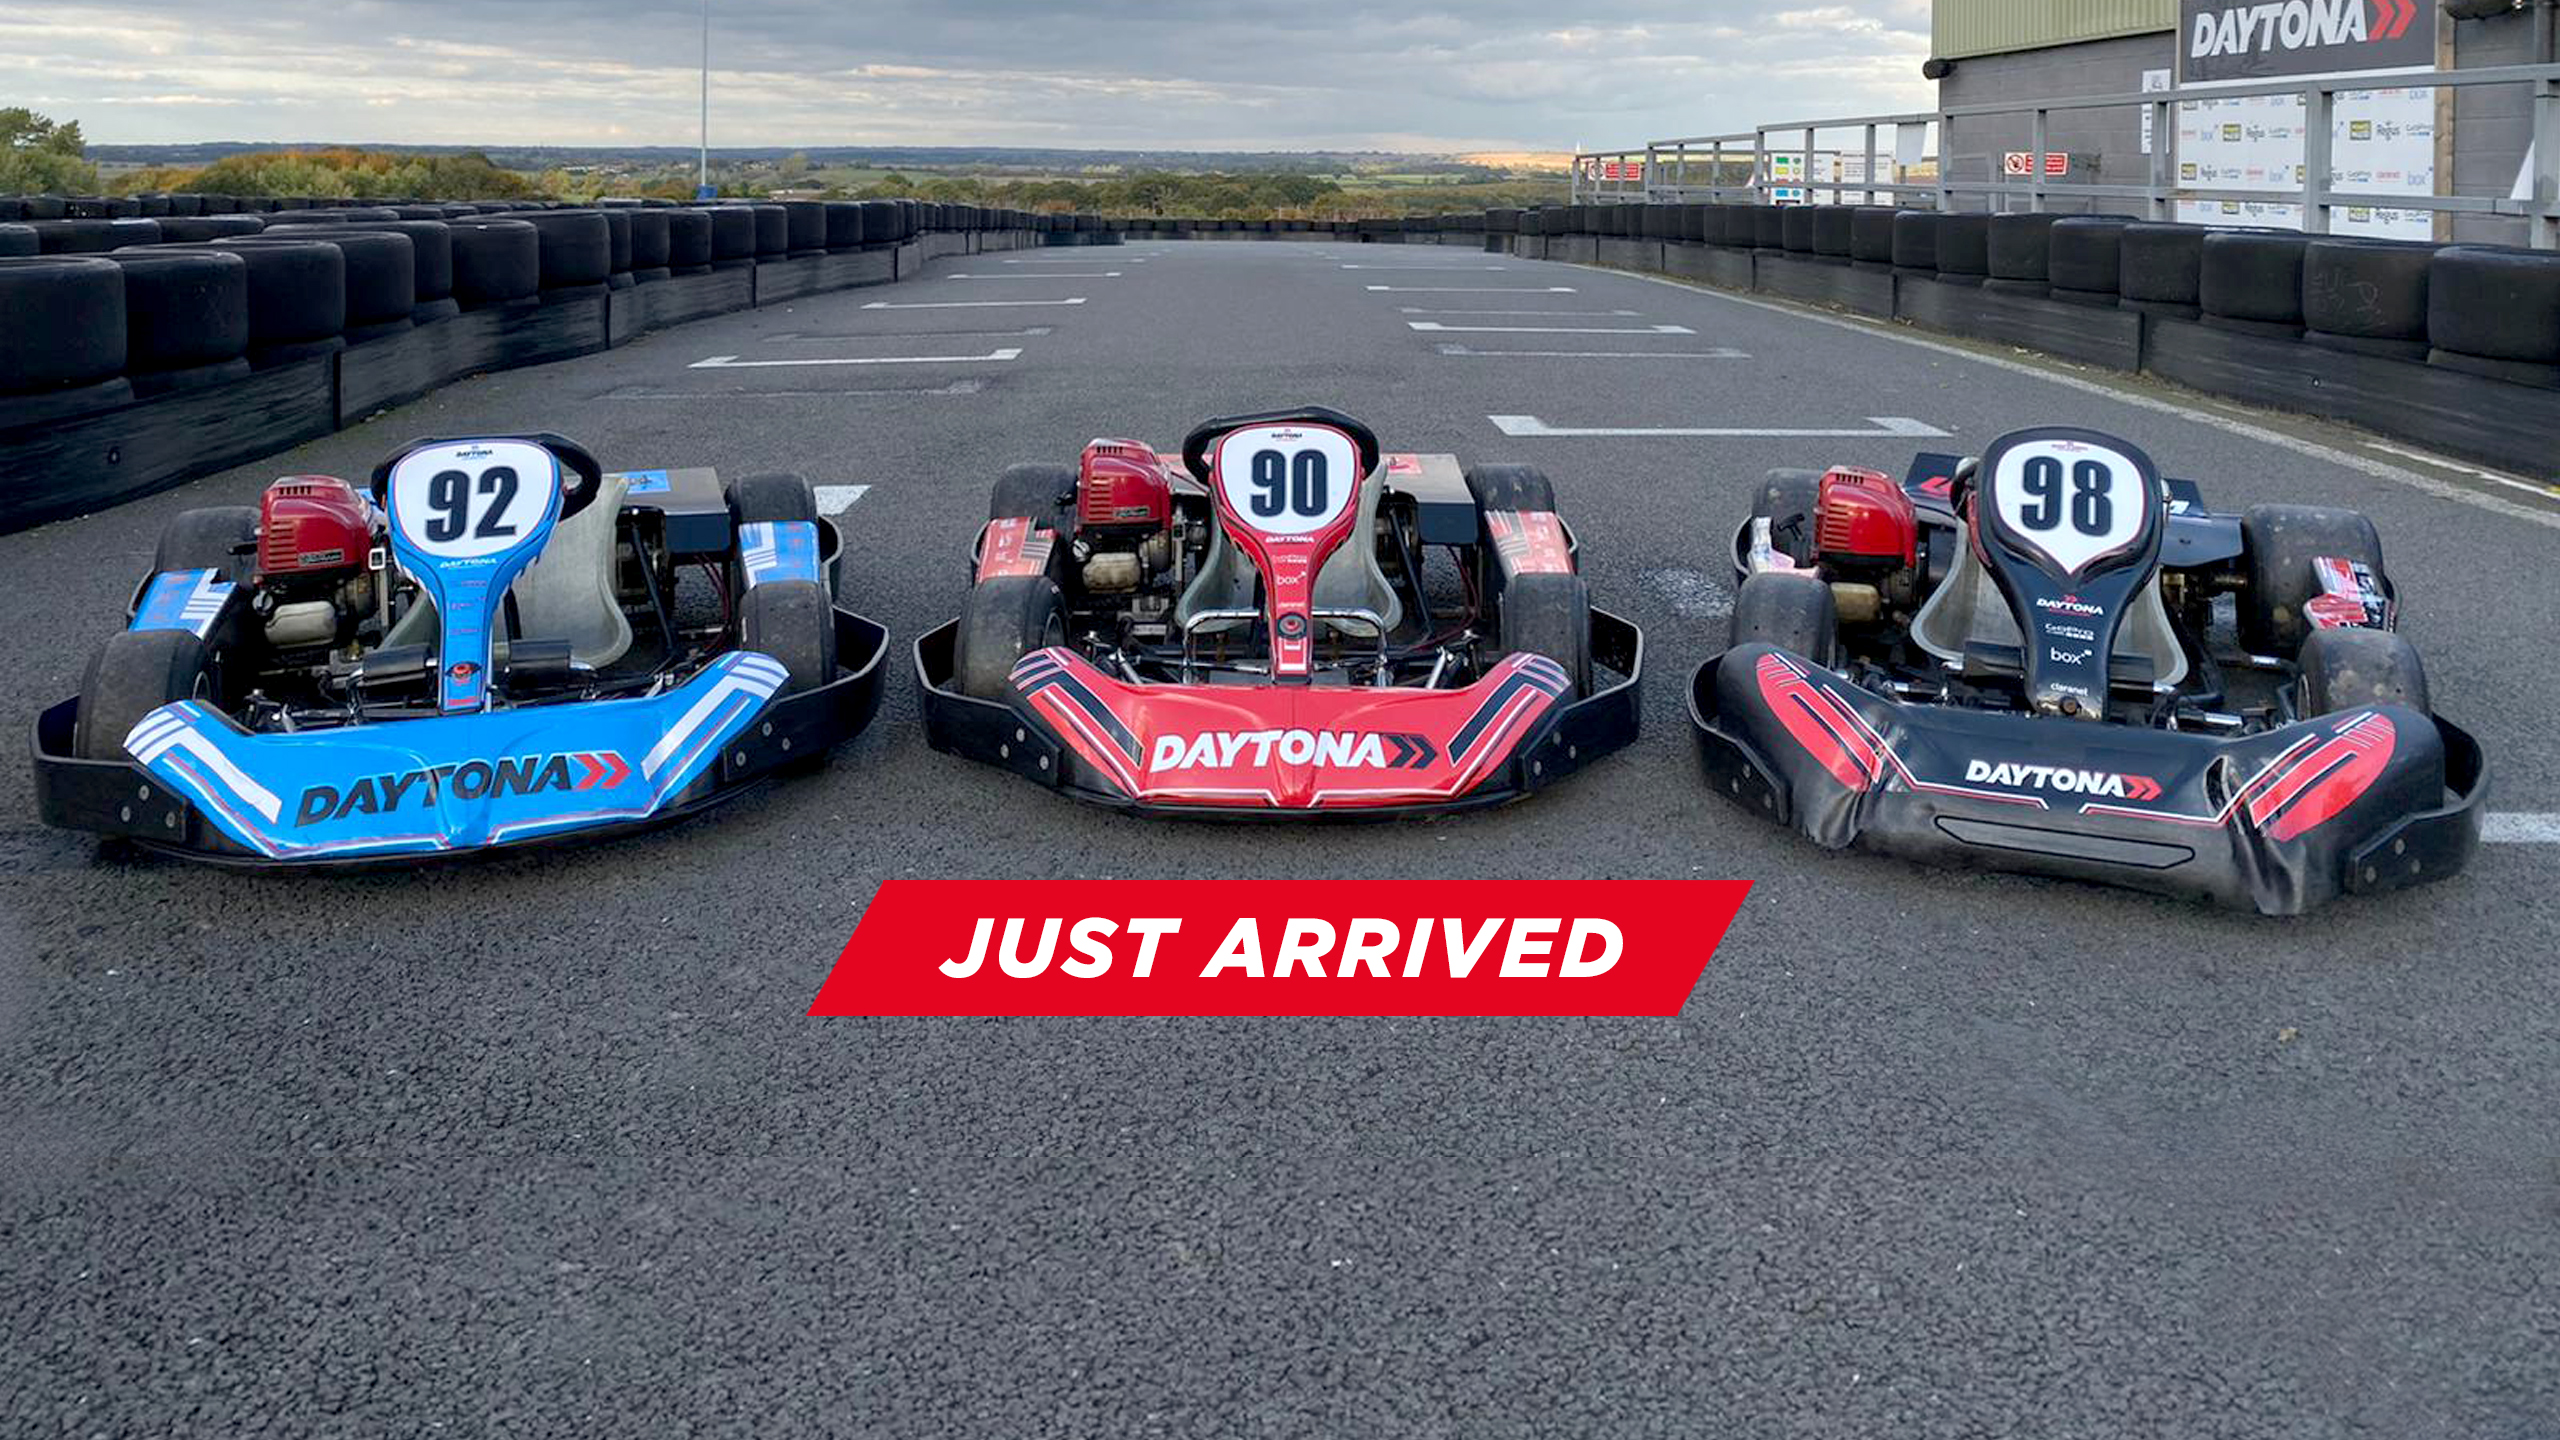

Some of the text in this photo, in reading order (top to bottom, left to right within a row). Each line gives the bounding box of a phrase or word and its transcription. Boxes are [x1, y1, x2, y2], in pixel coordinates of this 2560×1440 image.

[2190, 0, 2368, 58] DAYTONA
[425, 465, 519, 543] 92
[1250, 449, 1328, 518] 90
[2021, 455, 2113, 537] 98
[1265, 535, 1315, 543] DAYTONA
[1276, 575, 1299, 585] box
[2036, 597, 2104, 616] DAYTONA
[2050, 646, 2082, 665] box
[2050, 682, 2089, 697] claranet
[1150, 729, 1387, 773] DAYTONA
[295, 754, 572, 828] DAYTONA
[1965, 759, 2126, 799] DAYTONA
